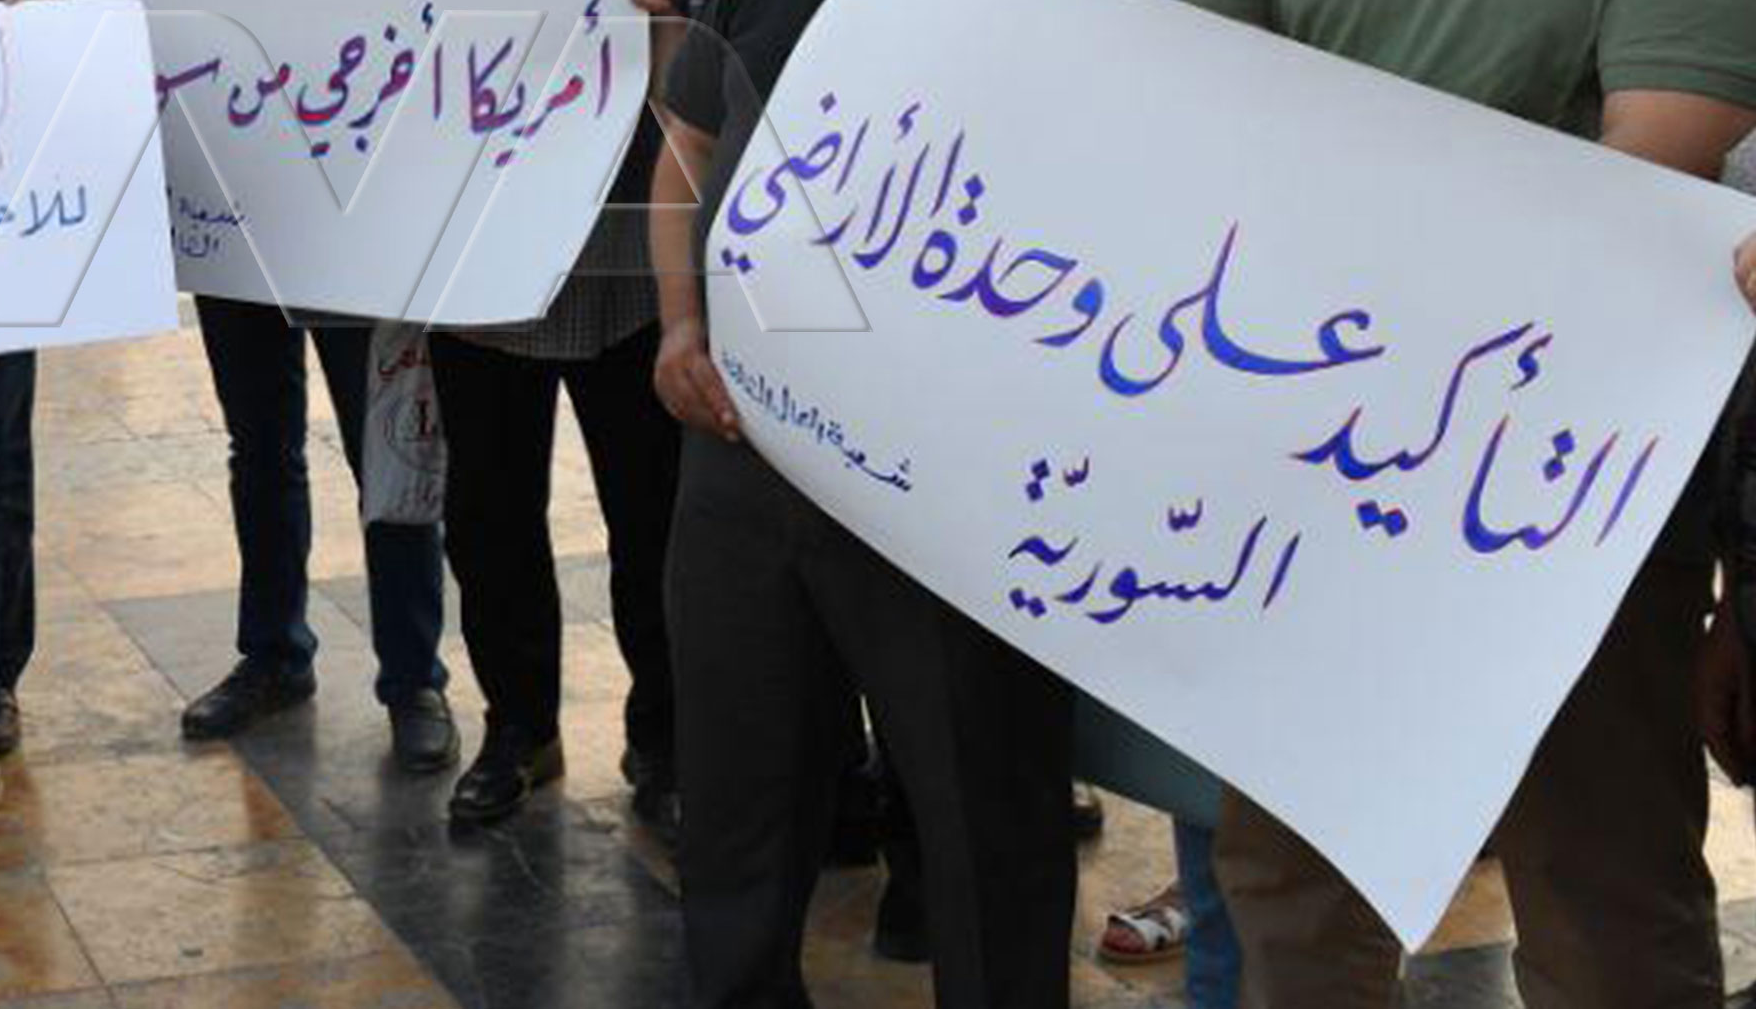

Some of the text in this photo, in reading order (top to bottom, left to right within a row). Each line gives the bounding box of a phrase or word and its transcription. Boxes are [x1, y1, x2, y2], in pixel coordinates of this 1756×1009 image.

[228, 63, 291, 127] من
[720, 92, 1659, 554] التأكيد على وحدة الأراضي
